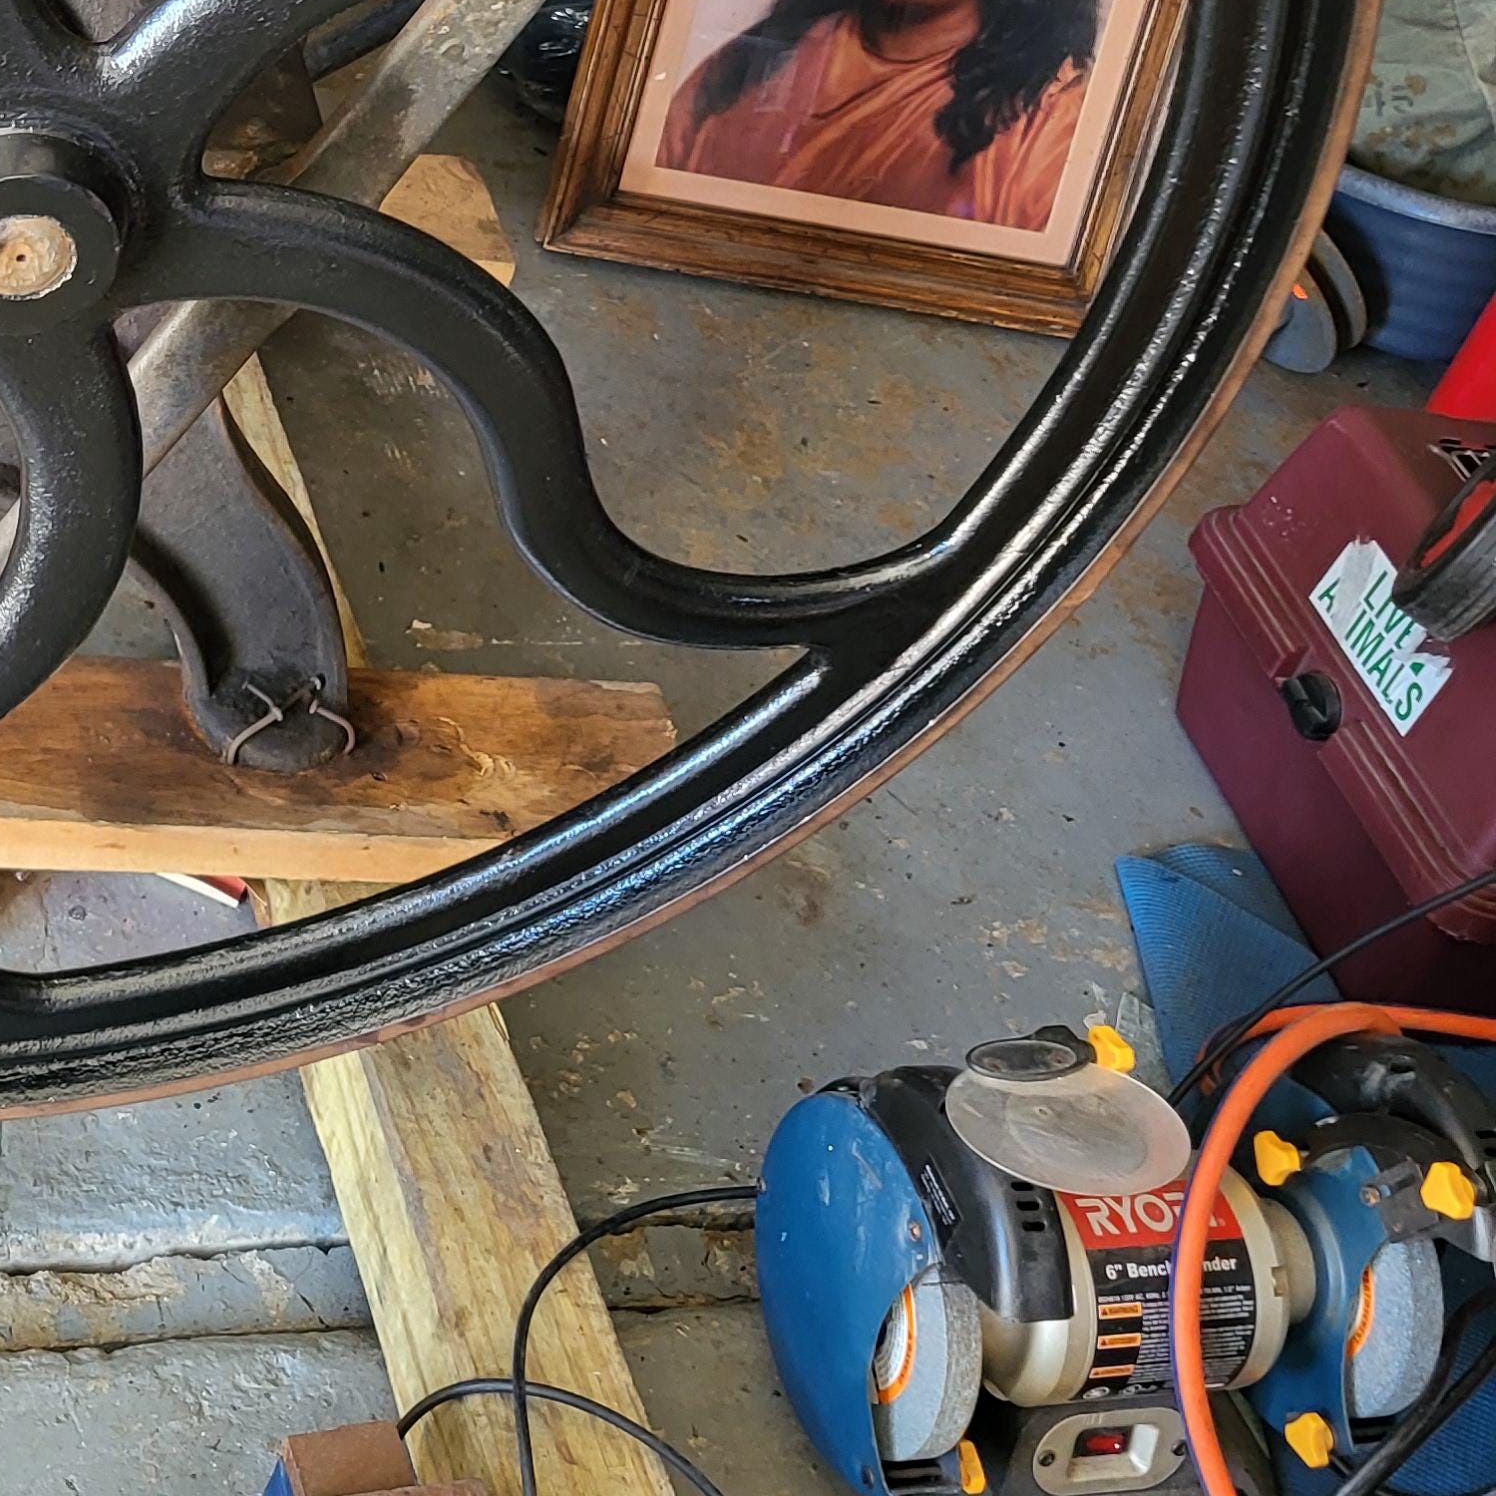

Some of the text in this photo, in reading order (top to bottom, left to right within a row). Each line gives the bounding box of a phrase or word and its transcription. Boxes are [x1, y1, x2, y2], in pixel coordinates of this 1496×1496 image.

[1363, 570, 1416, 650] LIVE
[1317, 577, 1423, 721] AIMALS
[1074, 1192, 1218, 1236] RYO
[1105, 1263, 1123, 1281] 6"
[1202, 1256, 1238, 1272] nder
